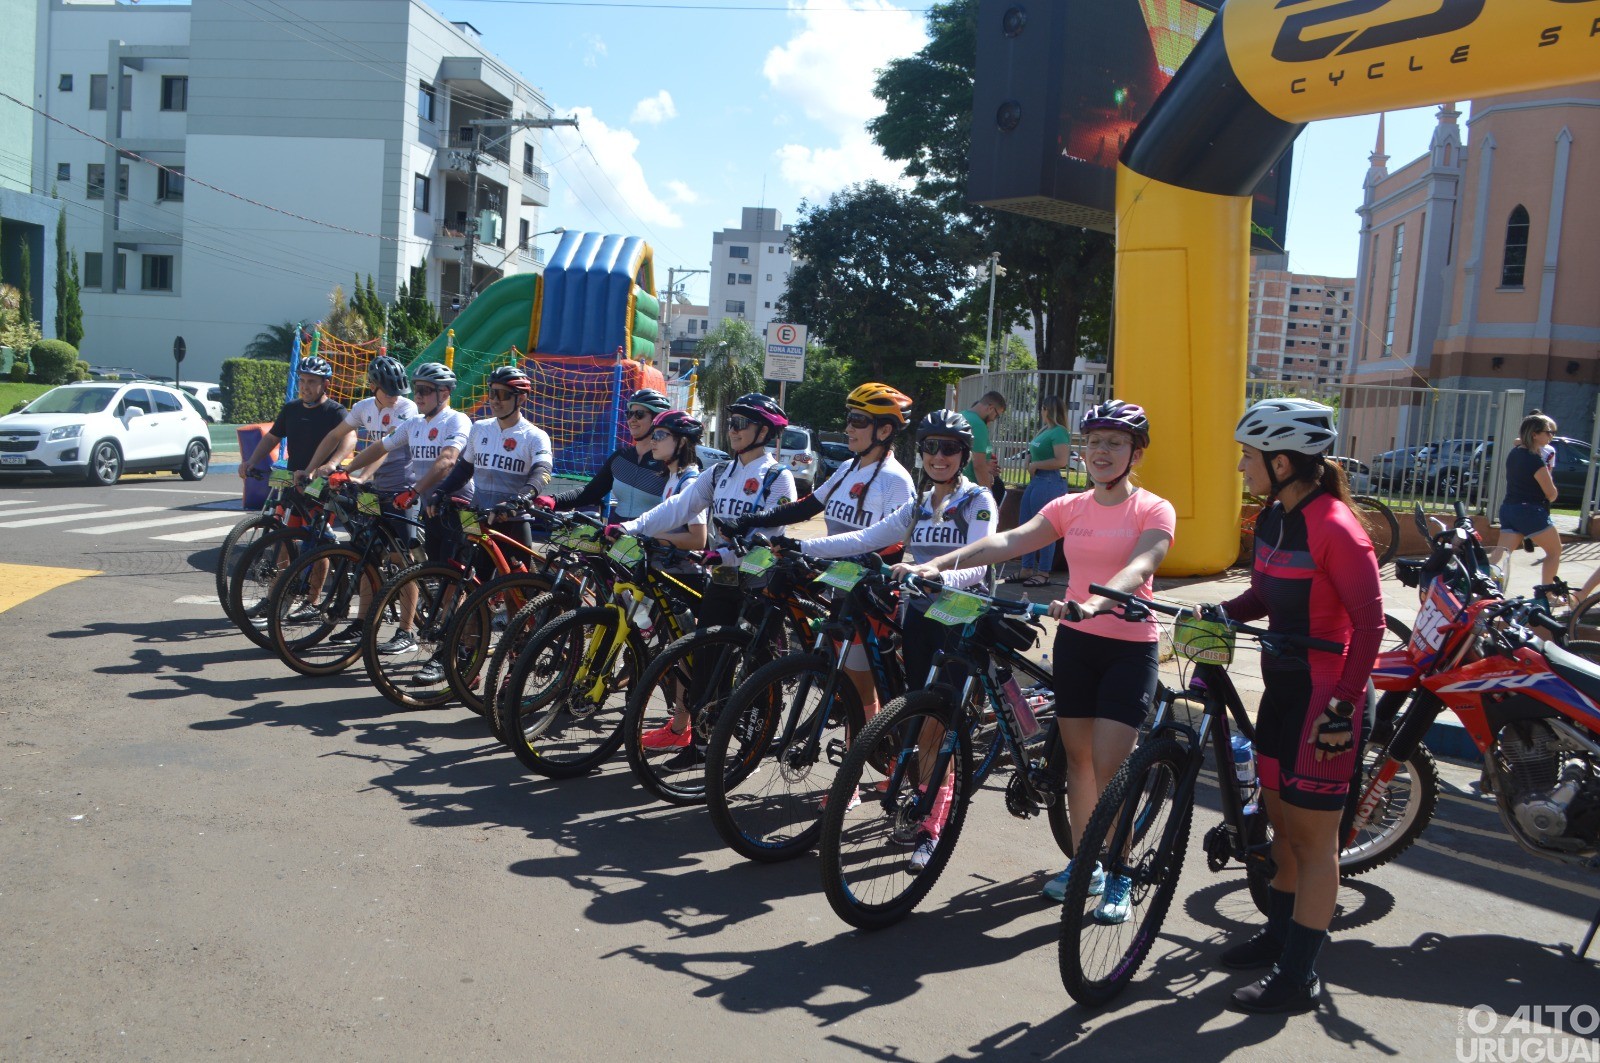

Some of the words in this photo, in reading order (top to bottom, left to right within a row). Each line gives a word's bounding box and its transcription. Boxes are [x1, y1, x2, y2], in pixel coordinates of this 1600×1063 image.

[1290, 44, 1471, 94] CYCLE
[782, 329, 791, 340] E
[769, 345, 785, 353] ZONA
[491, 454, 526, 473] TEAM
[832, 500, 874, 528] TEAM
[926, 526, 967, 545] TEAM
[1435, 671, 1558, 693] CRF
[1352, 779, 1390, 831] MOTUL
